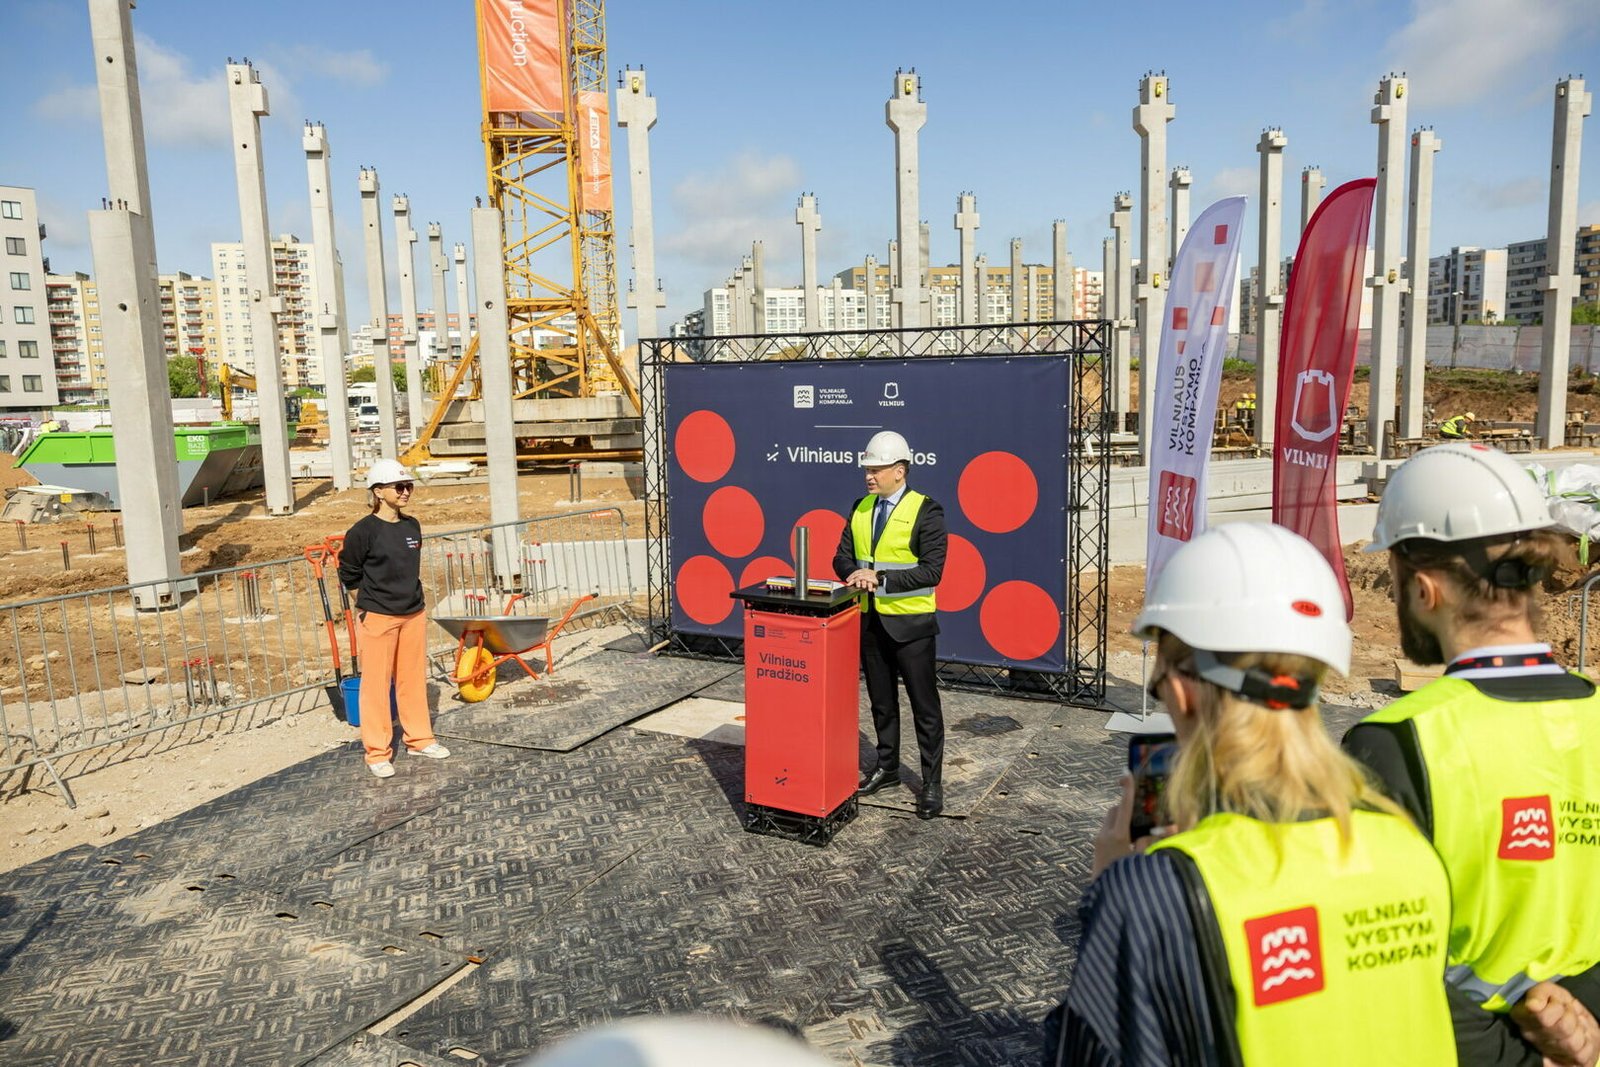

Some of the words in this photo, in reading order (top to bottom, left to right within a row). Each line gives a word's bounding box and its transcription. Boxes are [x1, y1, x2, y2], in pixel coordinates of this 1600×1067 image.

[590, 116, 600, 147] EIKA
[1169, 365, 1185, 449] VILNIAUS
[1177, 358, 1198, 452] VYSTYMO
[186, 435, 205, 443] EKO
[786, 446, 853, 463] Vilniaus
[857, 448, 937, 468] pios
[759, 652, 807, 669] Vilniaus
[756, 666, 810, 683] pradžios
[1342, 895, 1427, 927] VILNIAU
